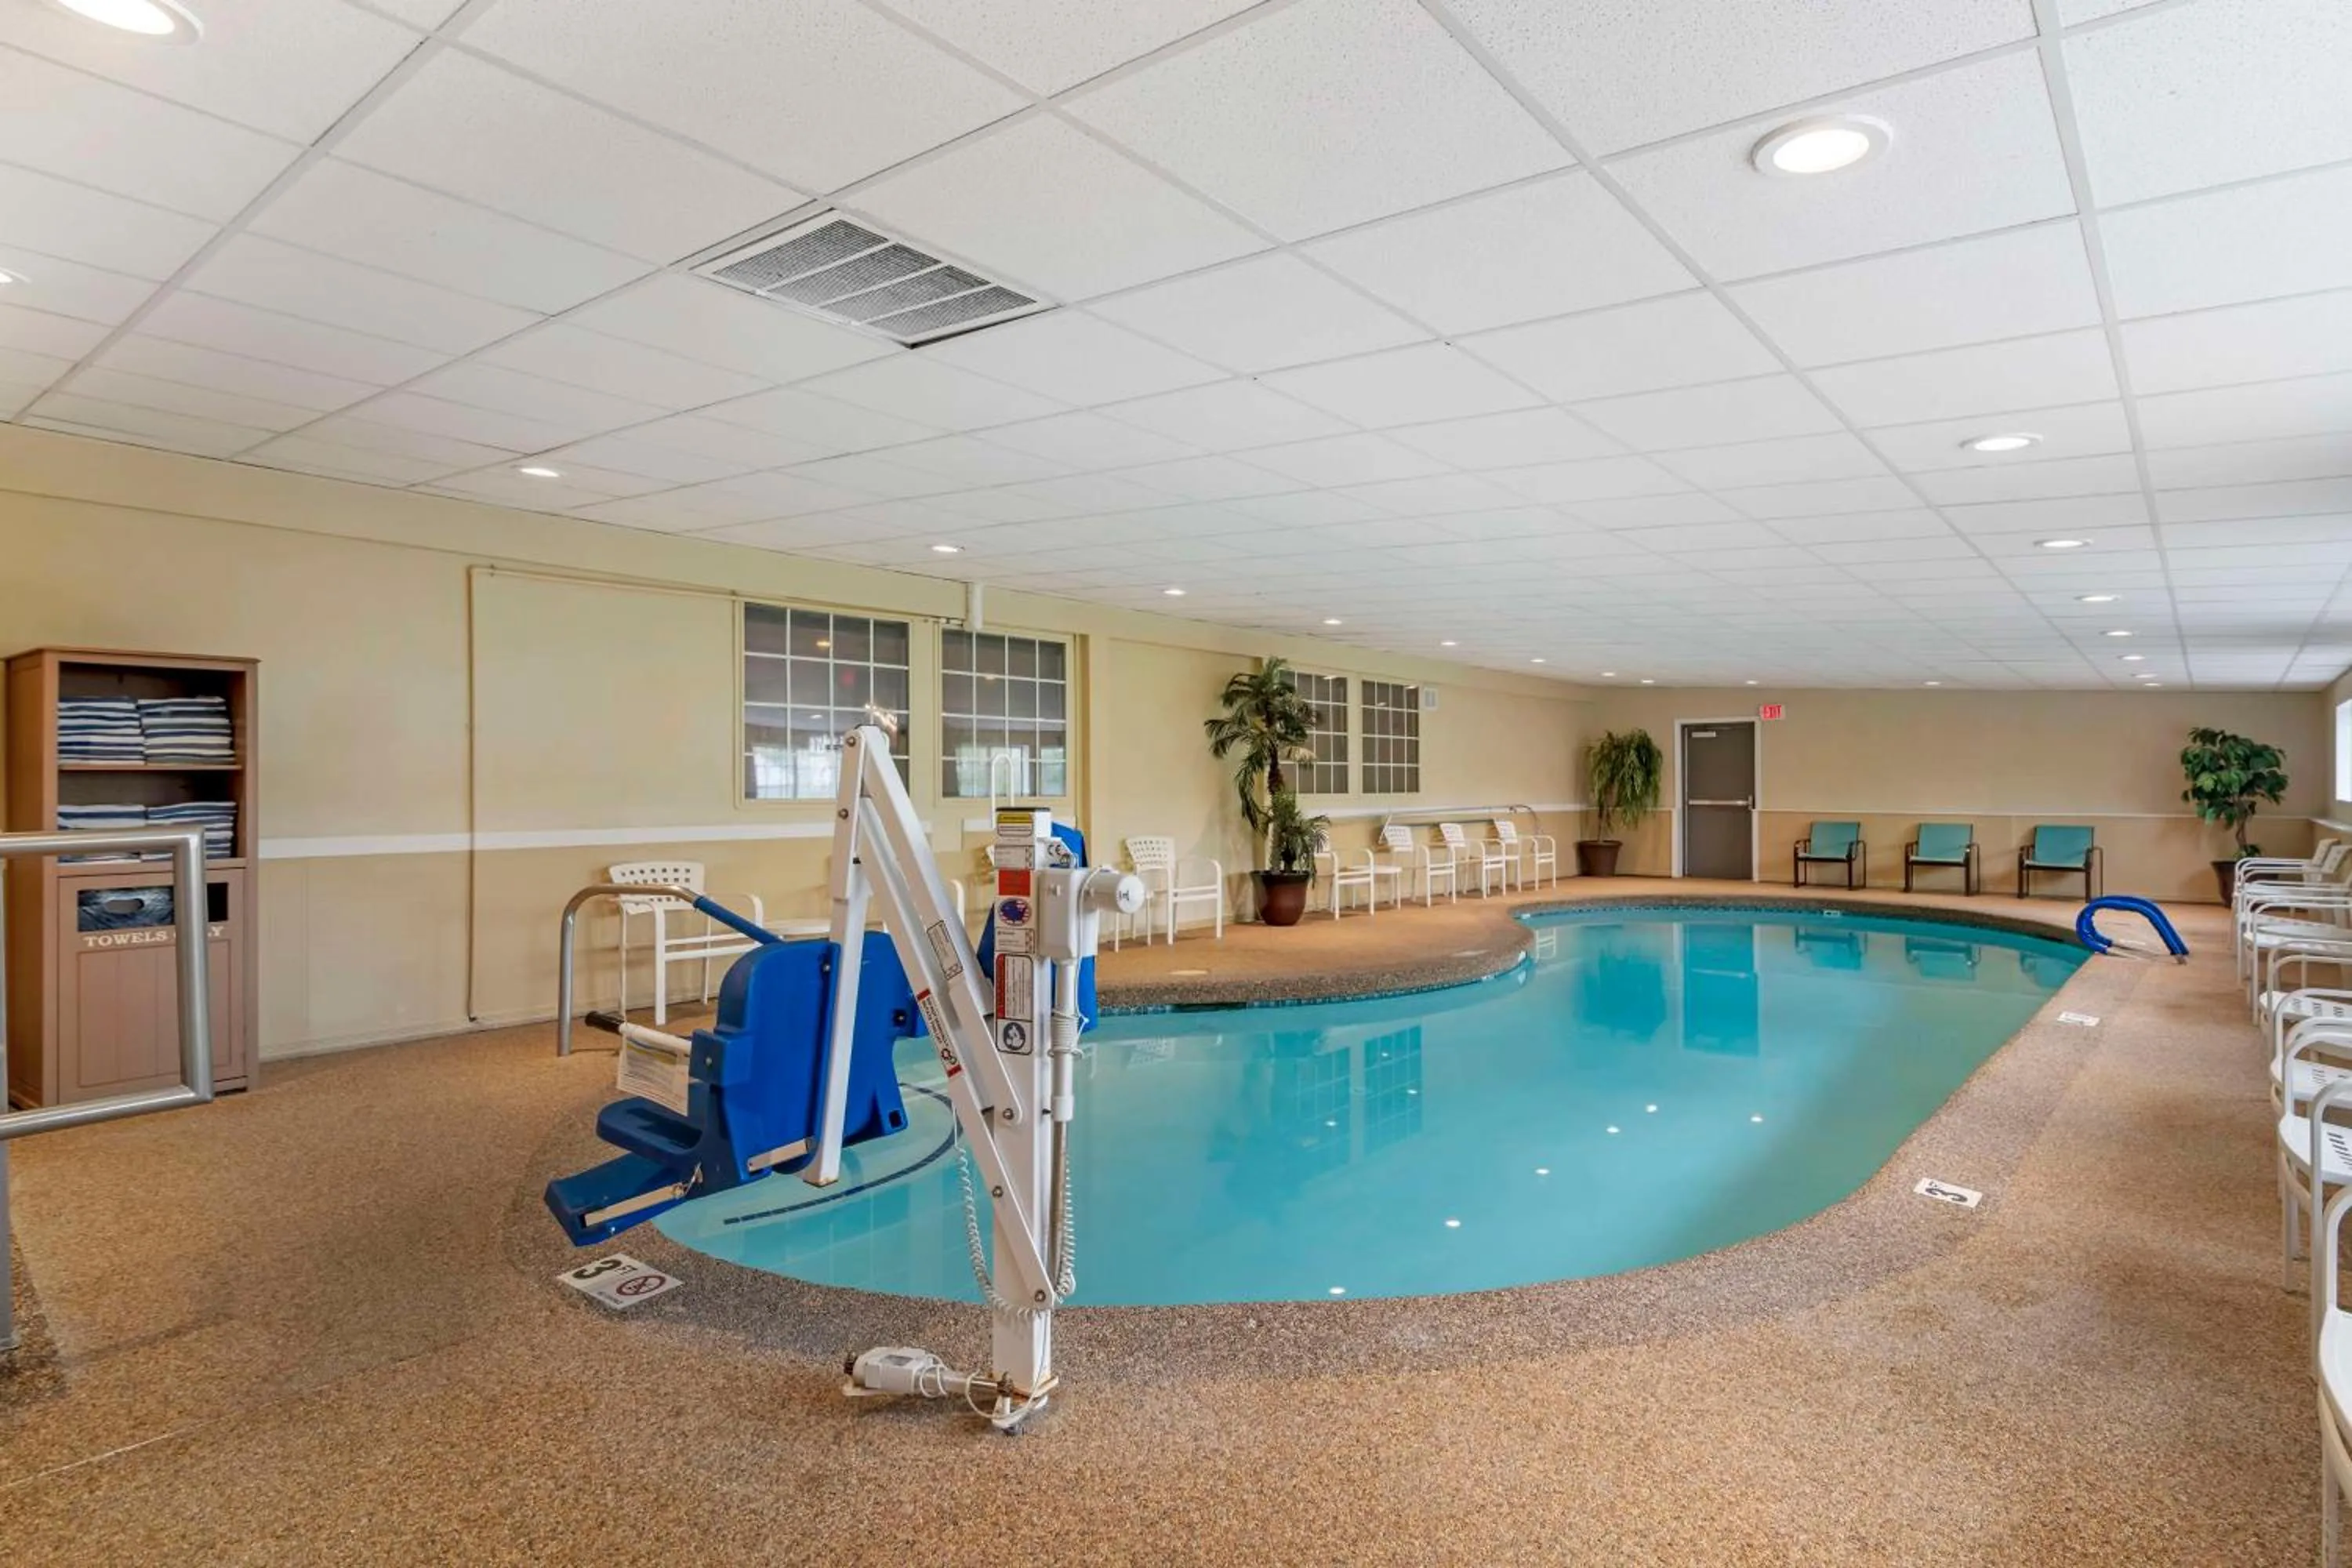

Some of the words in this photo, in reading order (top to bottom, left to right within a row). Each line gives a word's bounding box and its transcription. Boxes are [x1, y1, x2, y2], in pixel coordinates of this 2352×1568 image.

[83, 930, 168, 948] TOWELS
[1925, 1188, 1968, 1203] 3
[572, 1258, 622, 1280] 3
